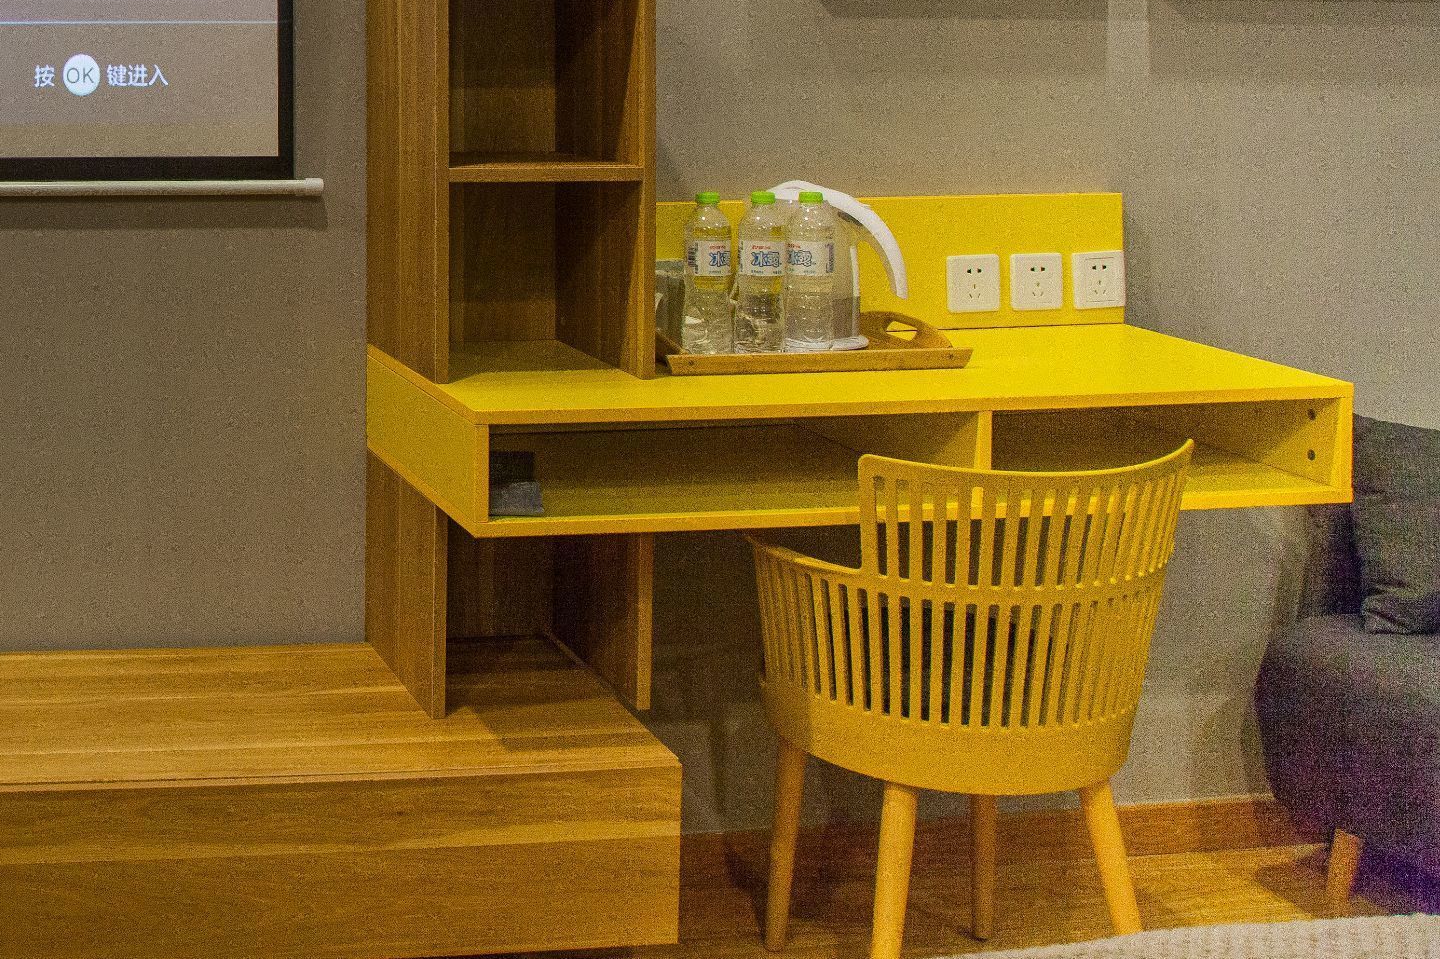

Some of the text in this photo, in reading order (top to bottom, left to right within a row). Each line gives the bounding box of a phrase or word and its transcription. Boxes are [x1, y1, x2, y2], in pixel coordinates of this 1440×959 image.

[34, 64, 169, 88] 按 OK 键进入
